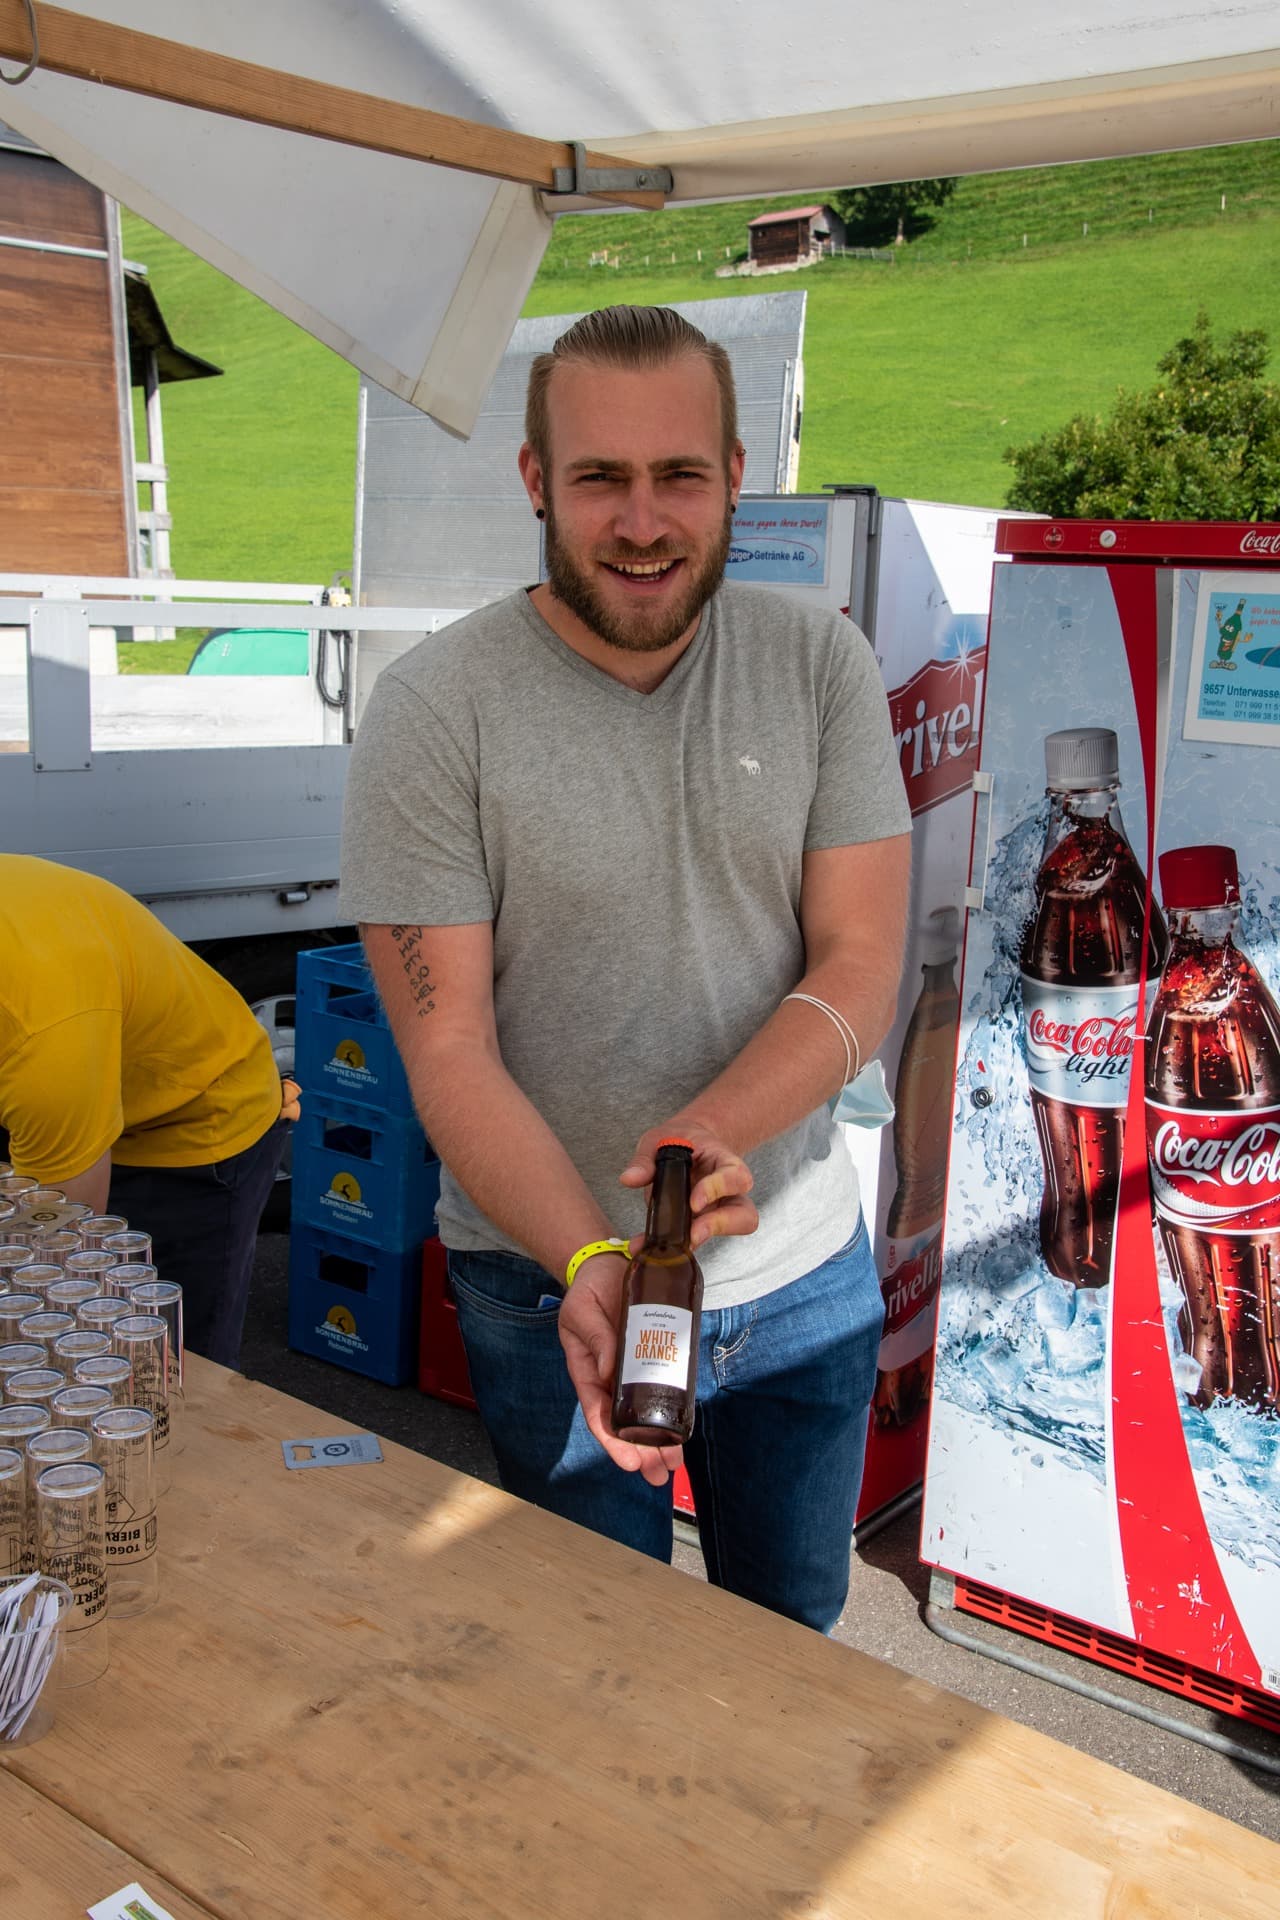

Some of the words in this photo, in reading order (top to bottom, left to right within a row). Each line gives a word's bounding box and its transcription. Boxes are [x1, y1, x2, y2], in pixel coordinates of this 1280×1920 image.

[754, 550, 791, 561] Getränke
[792, 551, 805, 561] AG
[1203, 683, 1225, 695] 9657
[1234, 700, 1248, 709] 071
[1233, 710, 1247, 719] 071
[1029, 1008, 1137, 1057] Coca-Cola
[1064, 1052, 1129, 1083] light
[640, 1329, 677, 1347] WHITE
[635, 1344, 678, 1362] ORANGE
